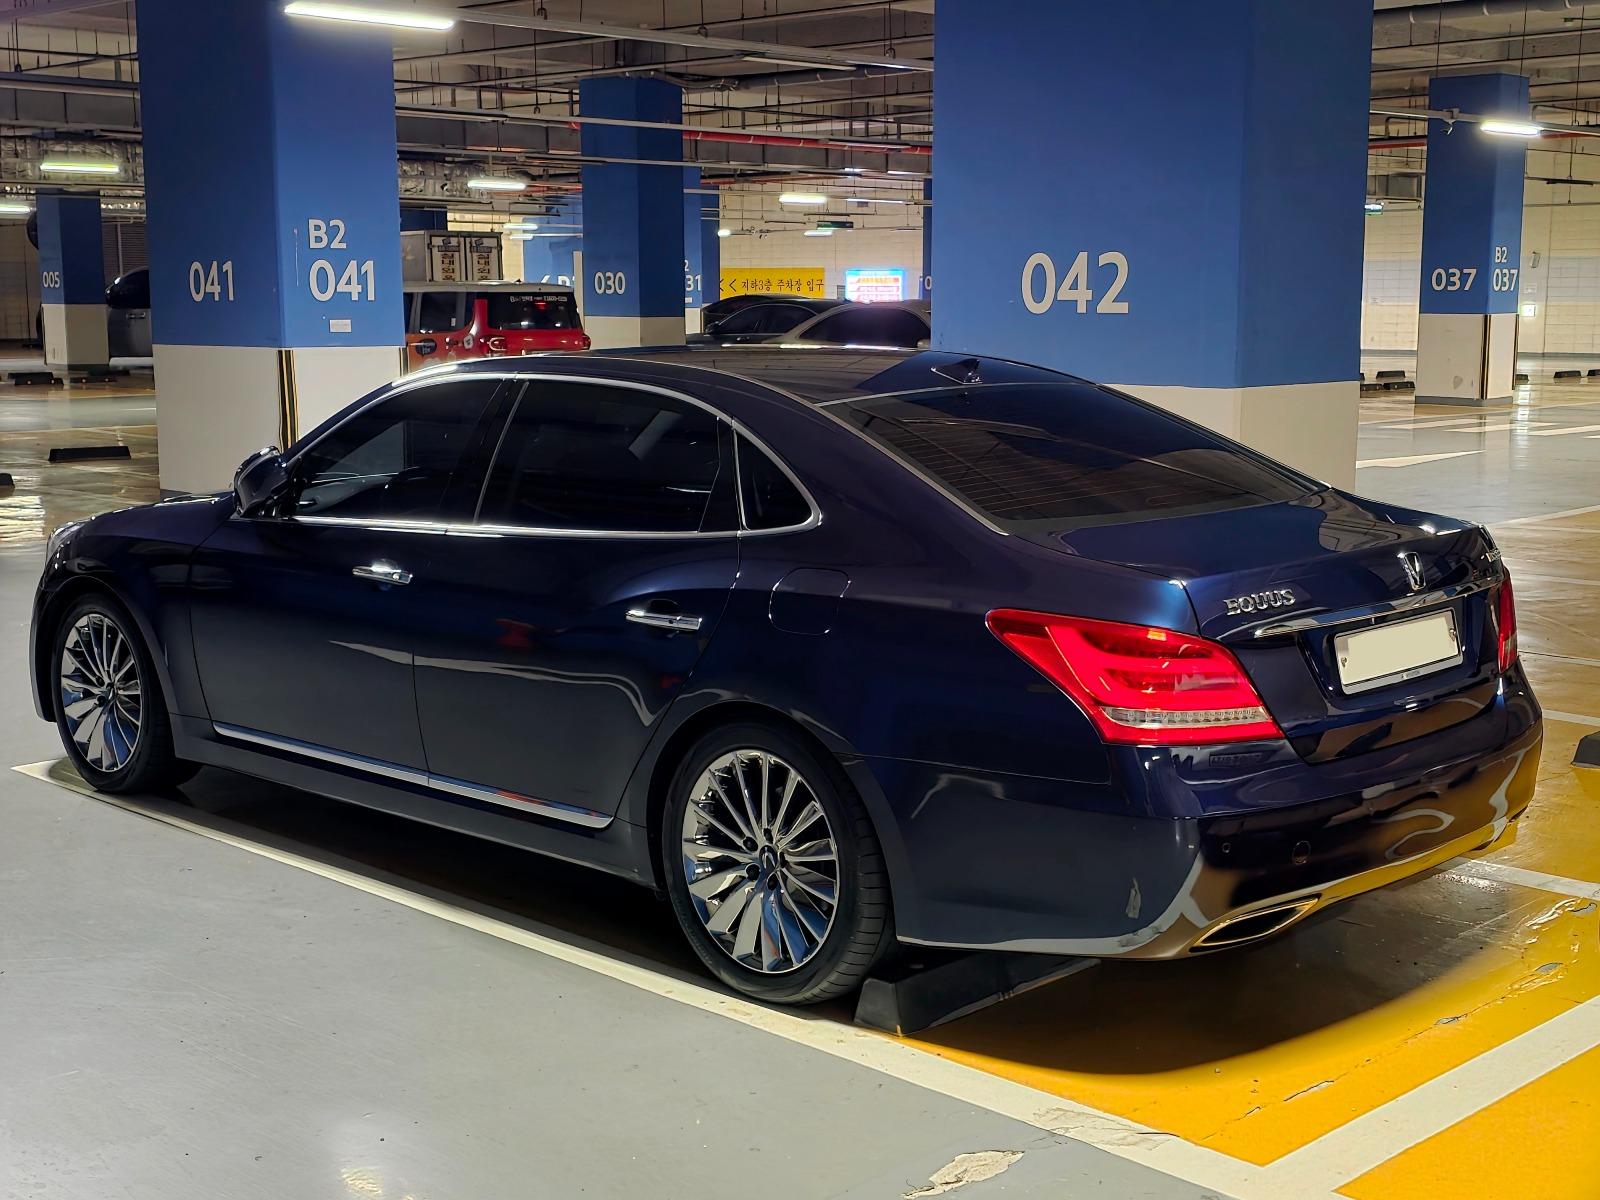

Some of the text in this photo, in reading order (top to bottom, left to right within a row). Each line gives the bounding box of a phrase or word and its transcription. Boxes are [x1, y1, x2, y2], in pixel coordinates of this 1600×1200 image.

[308, 218, 347, 249] B2
[1494, 246, 1508, 263] B2
[42, 271, 61, 288] 005
[189, 260, 235, 303] 041
[309, 259, 376, 302] 041
[594, 271, 626, 296] 030
[685, 274, 702, 291] 31
[741, 278, 825, 292] 지하3층 주차장 입구
[1021, 251, 1129, 315] 042
[1431, 268, 1478, 292] 037
[1492, 268, 1519, 292] 037
[1222, 588, 1297, 616] EQUUS
